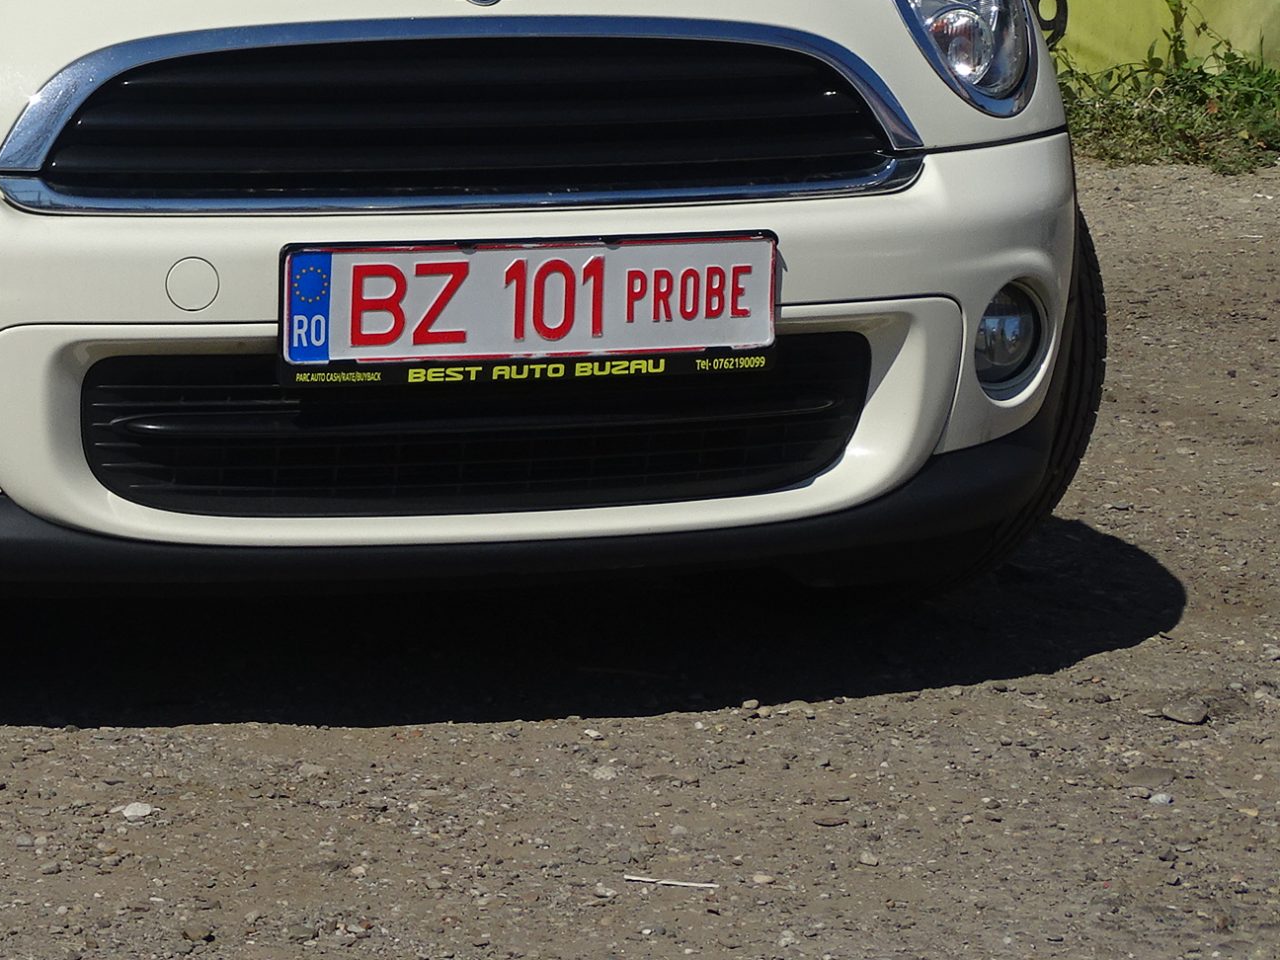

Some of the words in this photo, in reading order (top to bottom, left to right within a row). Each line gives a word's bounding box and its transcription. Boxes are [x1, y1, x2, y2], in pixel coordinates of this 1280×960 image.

[350, 260, 470, 347] BZ
[504, 255, 606, 342] 101
[625, 265, 753, 323] PROBE
[292, 314, 326, 347] RO
[310, 372, 326, 382] AUTO
[407, 366, 483, 383] BEST
[492, 363, 565, 380] AUTO
[574, 358, 666, 377] BUZAU
[712, 356, 766, 370] 0762190099
